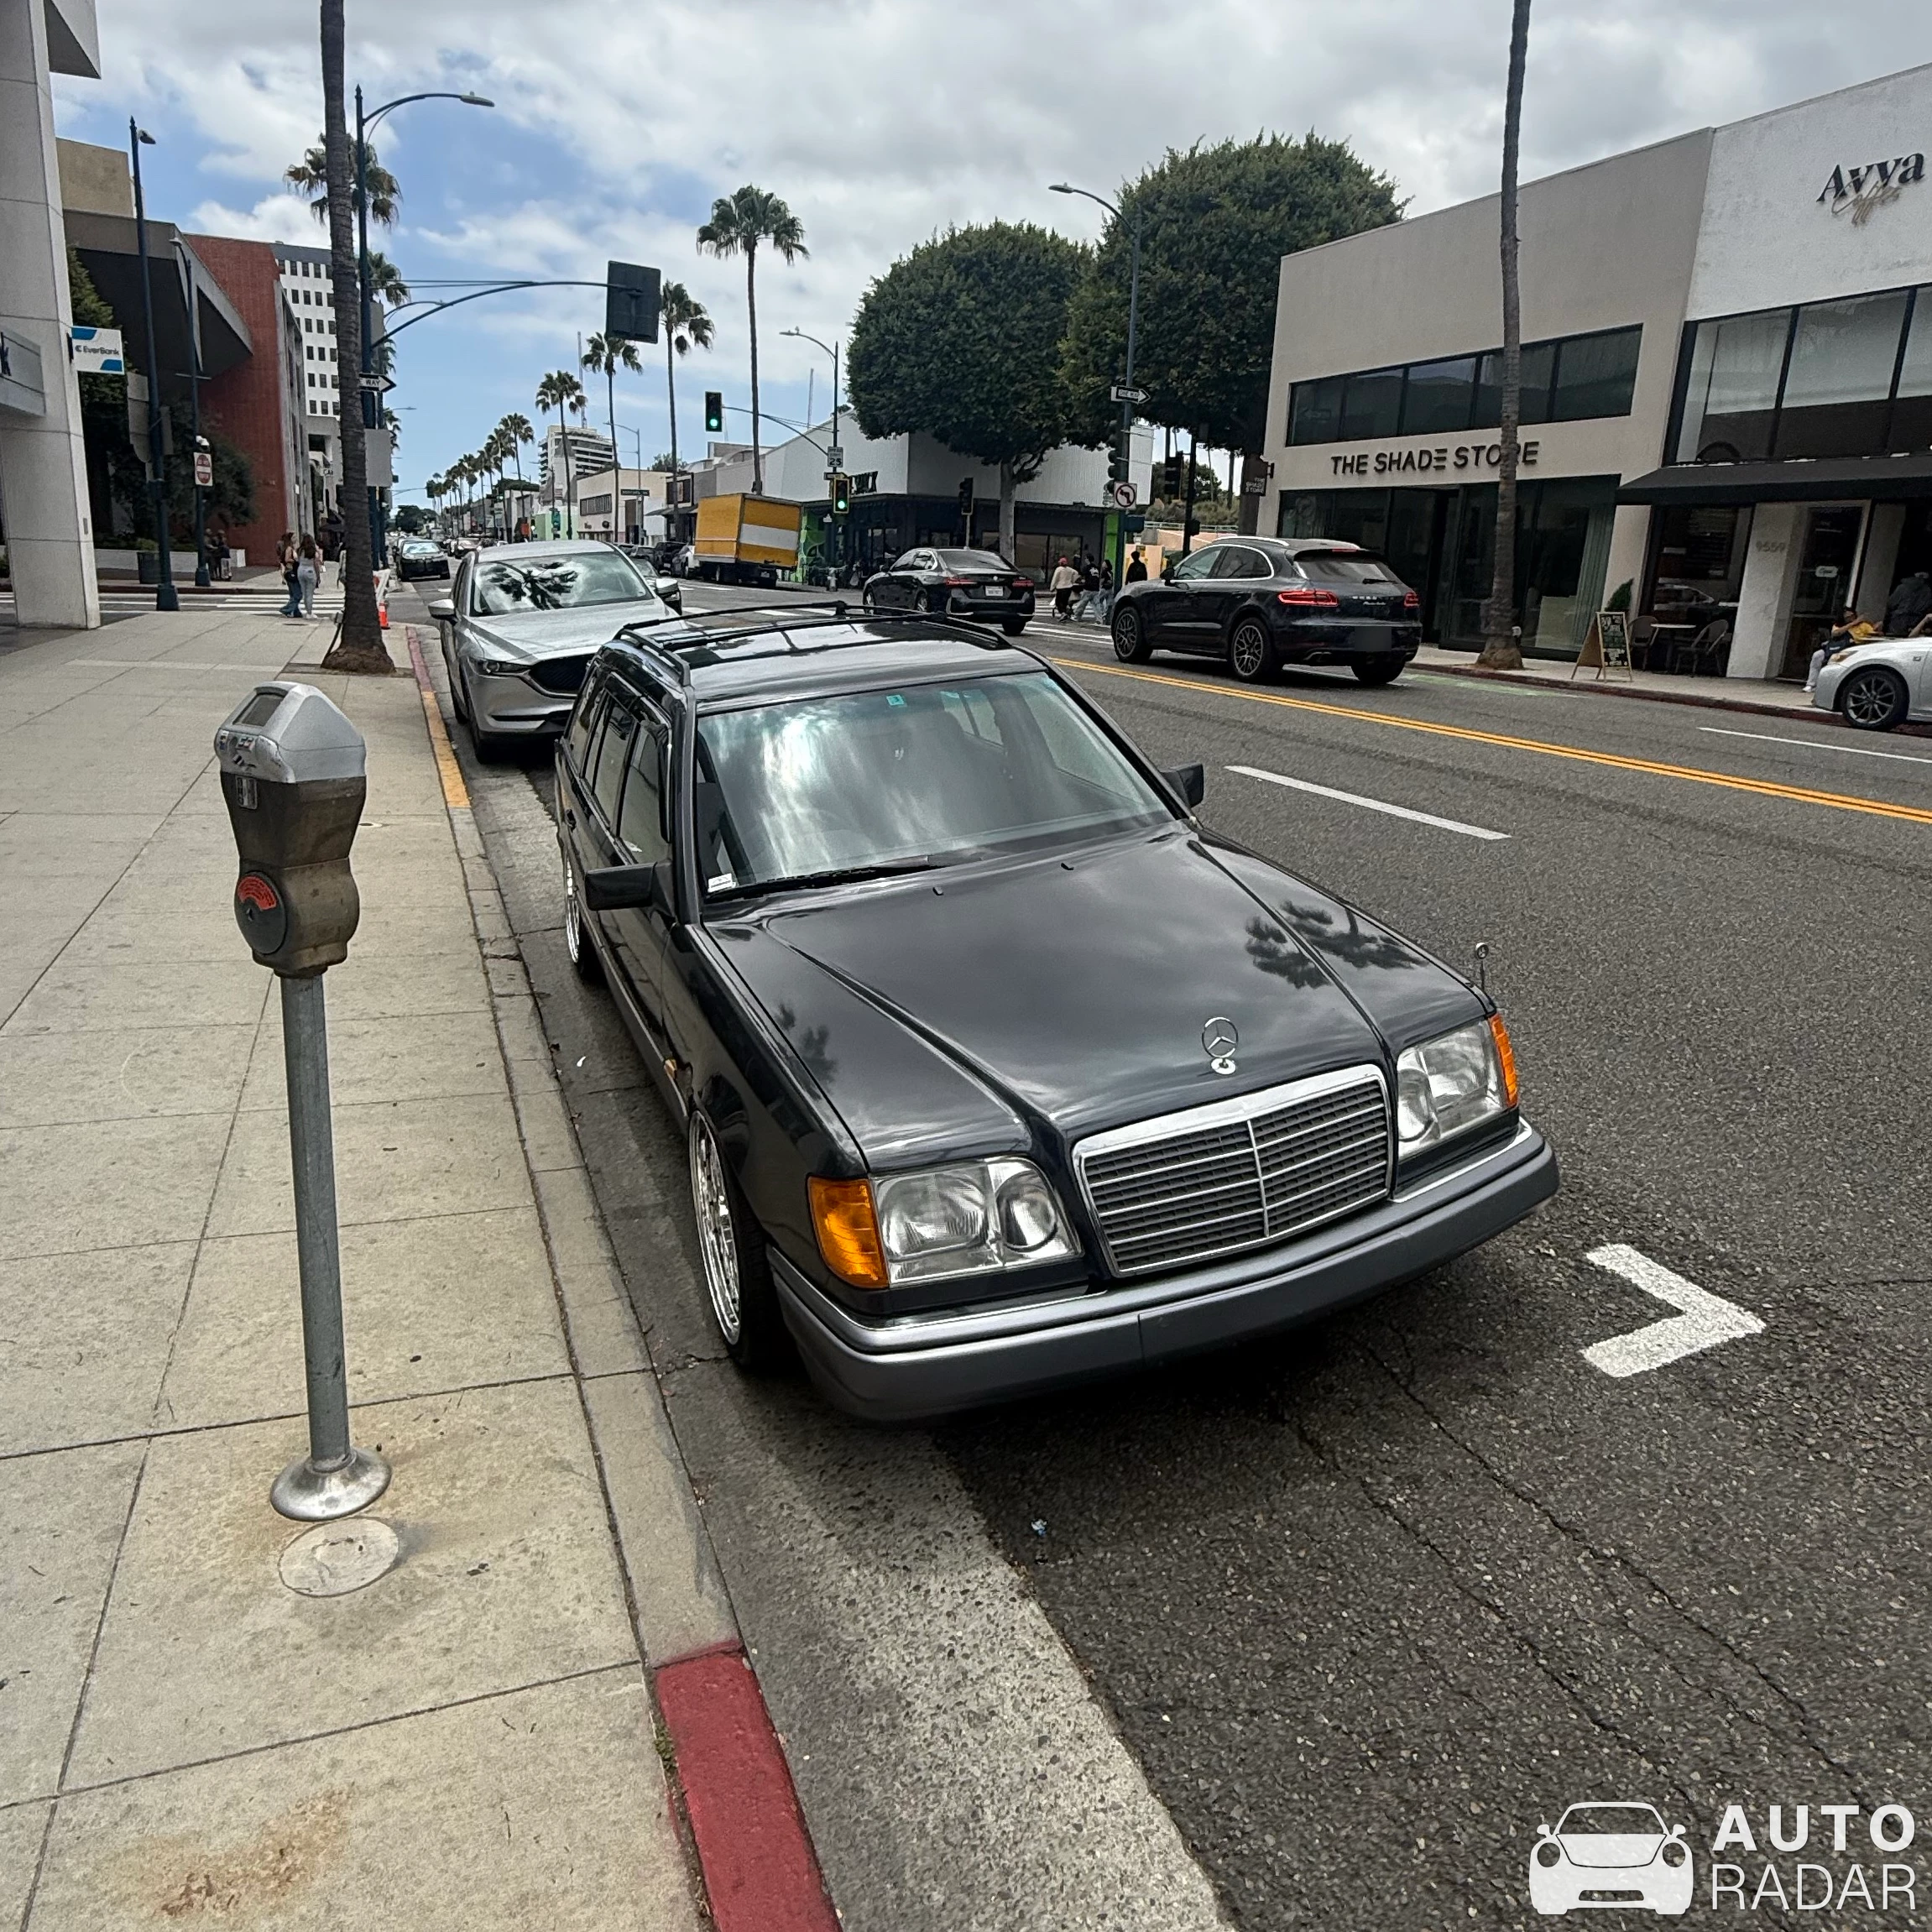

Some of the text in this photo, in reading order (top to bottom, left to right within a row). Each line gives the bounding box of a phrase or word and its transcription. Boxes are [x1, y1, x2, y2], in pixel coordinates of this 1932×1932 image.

[829, 457, 842, 466] 25
[1331, 454, 1369, 475] THE
[1374, 448, 1448, 473] SHADE
